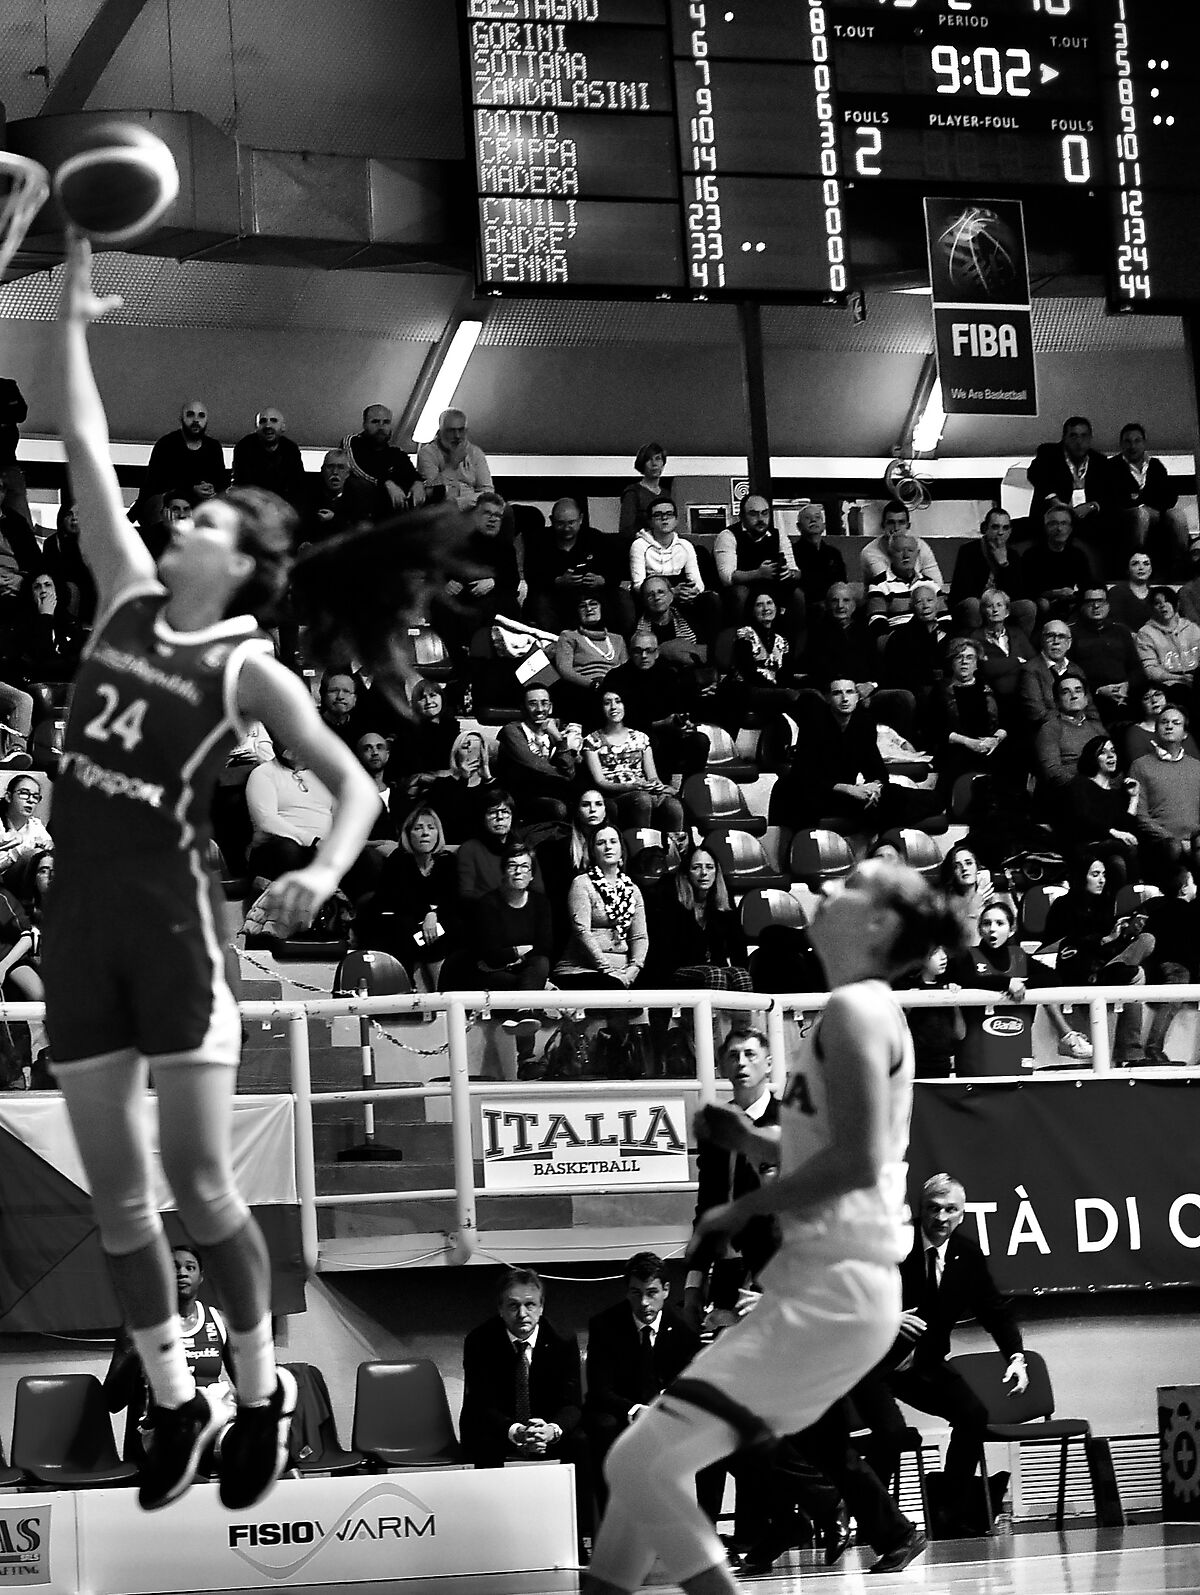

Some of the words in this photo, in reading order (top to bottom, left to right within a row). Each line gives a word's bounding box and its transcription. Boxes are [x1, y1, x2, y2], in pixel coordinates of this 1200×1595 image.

[689, 4, 706, 27] 4
[809, 8, 825, 34] 8
[834, 25, 875, 38] T.OUT
[938, 14, 989, 28] PERIOD
[472, 22, 567, 51] GORINI
[692, 31, 708, 56] 6
[812, 36, 828, 62] 0
[1050, 35, 1089, 49] T.OUT
[1114, 22, 1128, 49] 3
[474, 49, 587, 79] SOTTANA
[695, 61, 710, 85] 7
[814, 64, 830, 92] 0
[931, 44, 1032, 97] 9:02
[1116, 50, 1131, 76] 5
[475, 77, 650, 109] ZANDALASINI
[696, 89, 712, 114] 9
[816, 93, 832, 119] 6
[1118, 78, 1134, 105] 8
[478, 109, 560, 138] DOTTO
[691, 117, 714, 143] 10
[819, 121, 835, 147] 3
[844, 111, 890, 124] FOULS
[929, 114, 1020, 129] PLAYER-FOUL
[1051, 118, 1094, 132] FOULS
[1121, 106, 1136, 133] 9
[479, 138, 577, 167] CRIPPA
[693, 146, 717, 170] 14
[821, 149, 837, 176] 0
[855, 126, 882, 176] 2
[1062, 134, 1091, 183] 0
[1116, 133, 1139, 160] 10
[481, 166, 579, 194] MADERA
[695, 176, 719, 201] 16
[823, 179, 839, 206] 0
[1119, 162, 1141, 186] 11
[483, 197, 578, 227] CINILI
[689, 204, 721, 231] 23
[825, 207, 841, 234] 0
[1121, 190, 1143, 217] 12
[1123, 218, 1146, 244] 13
[691, 233, 723, 260] 33
[828, 236, 844, 263] 0
[1118, 245, 1148, 272] 24
[486, 254, 569, 283] PENNA
[692, 263, 725, 287] 41
[830, 264, 846, 292] 0
[1120, 275, 1150, 299] 44
[951, 323, 1018, 358] FIBA
[950, 388, 966, 399] We
[968, 388, 984, 400] Are
[985, 388, 1027, 400] Basketball
[84, 683, 149, 751] 24
[483, 1105, 686, 1159] ITALIA
[533, 1159, 641, 1176] BASKETBALL
[1074, 1196, 1141, 1253] DI
